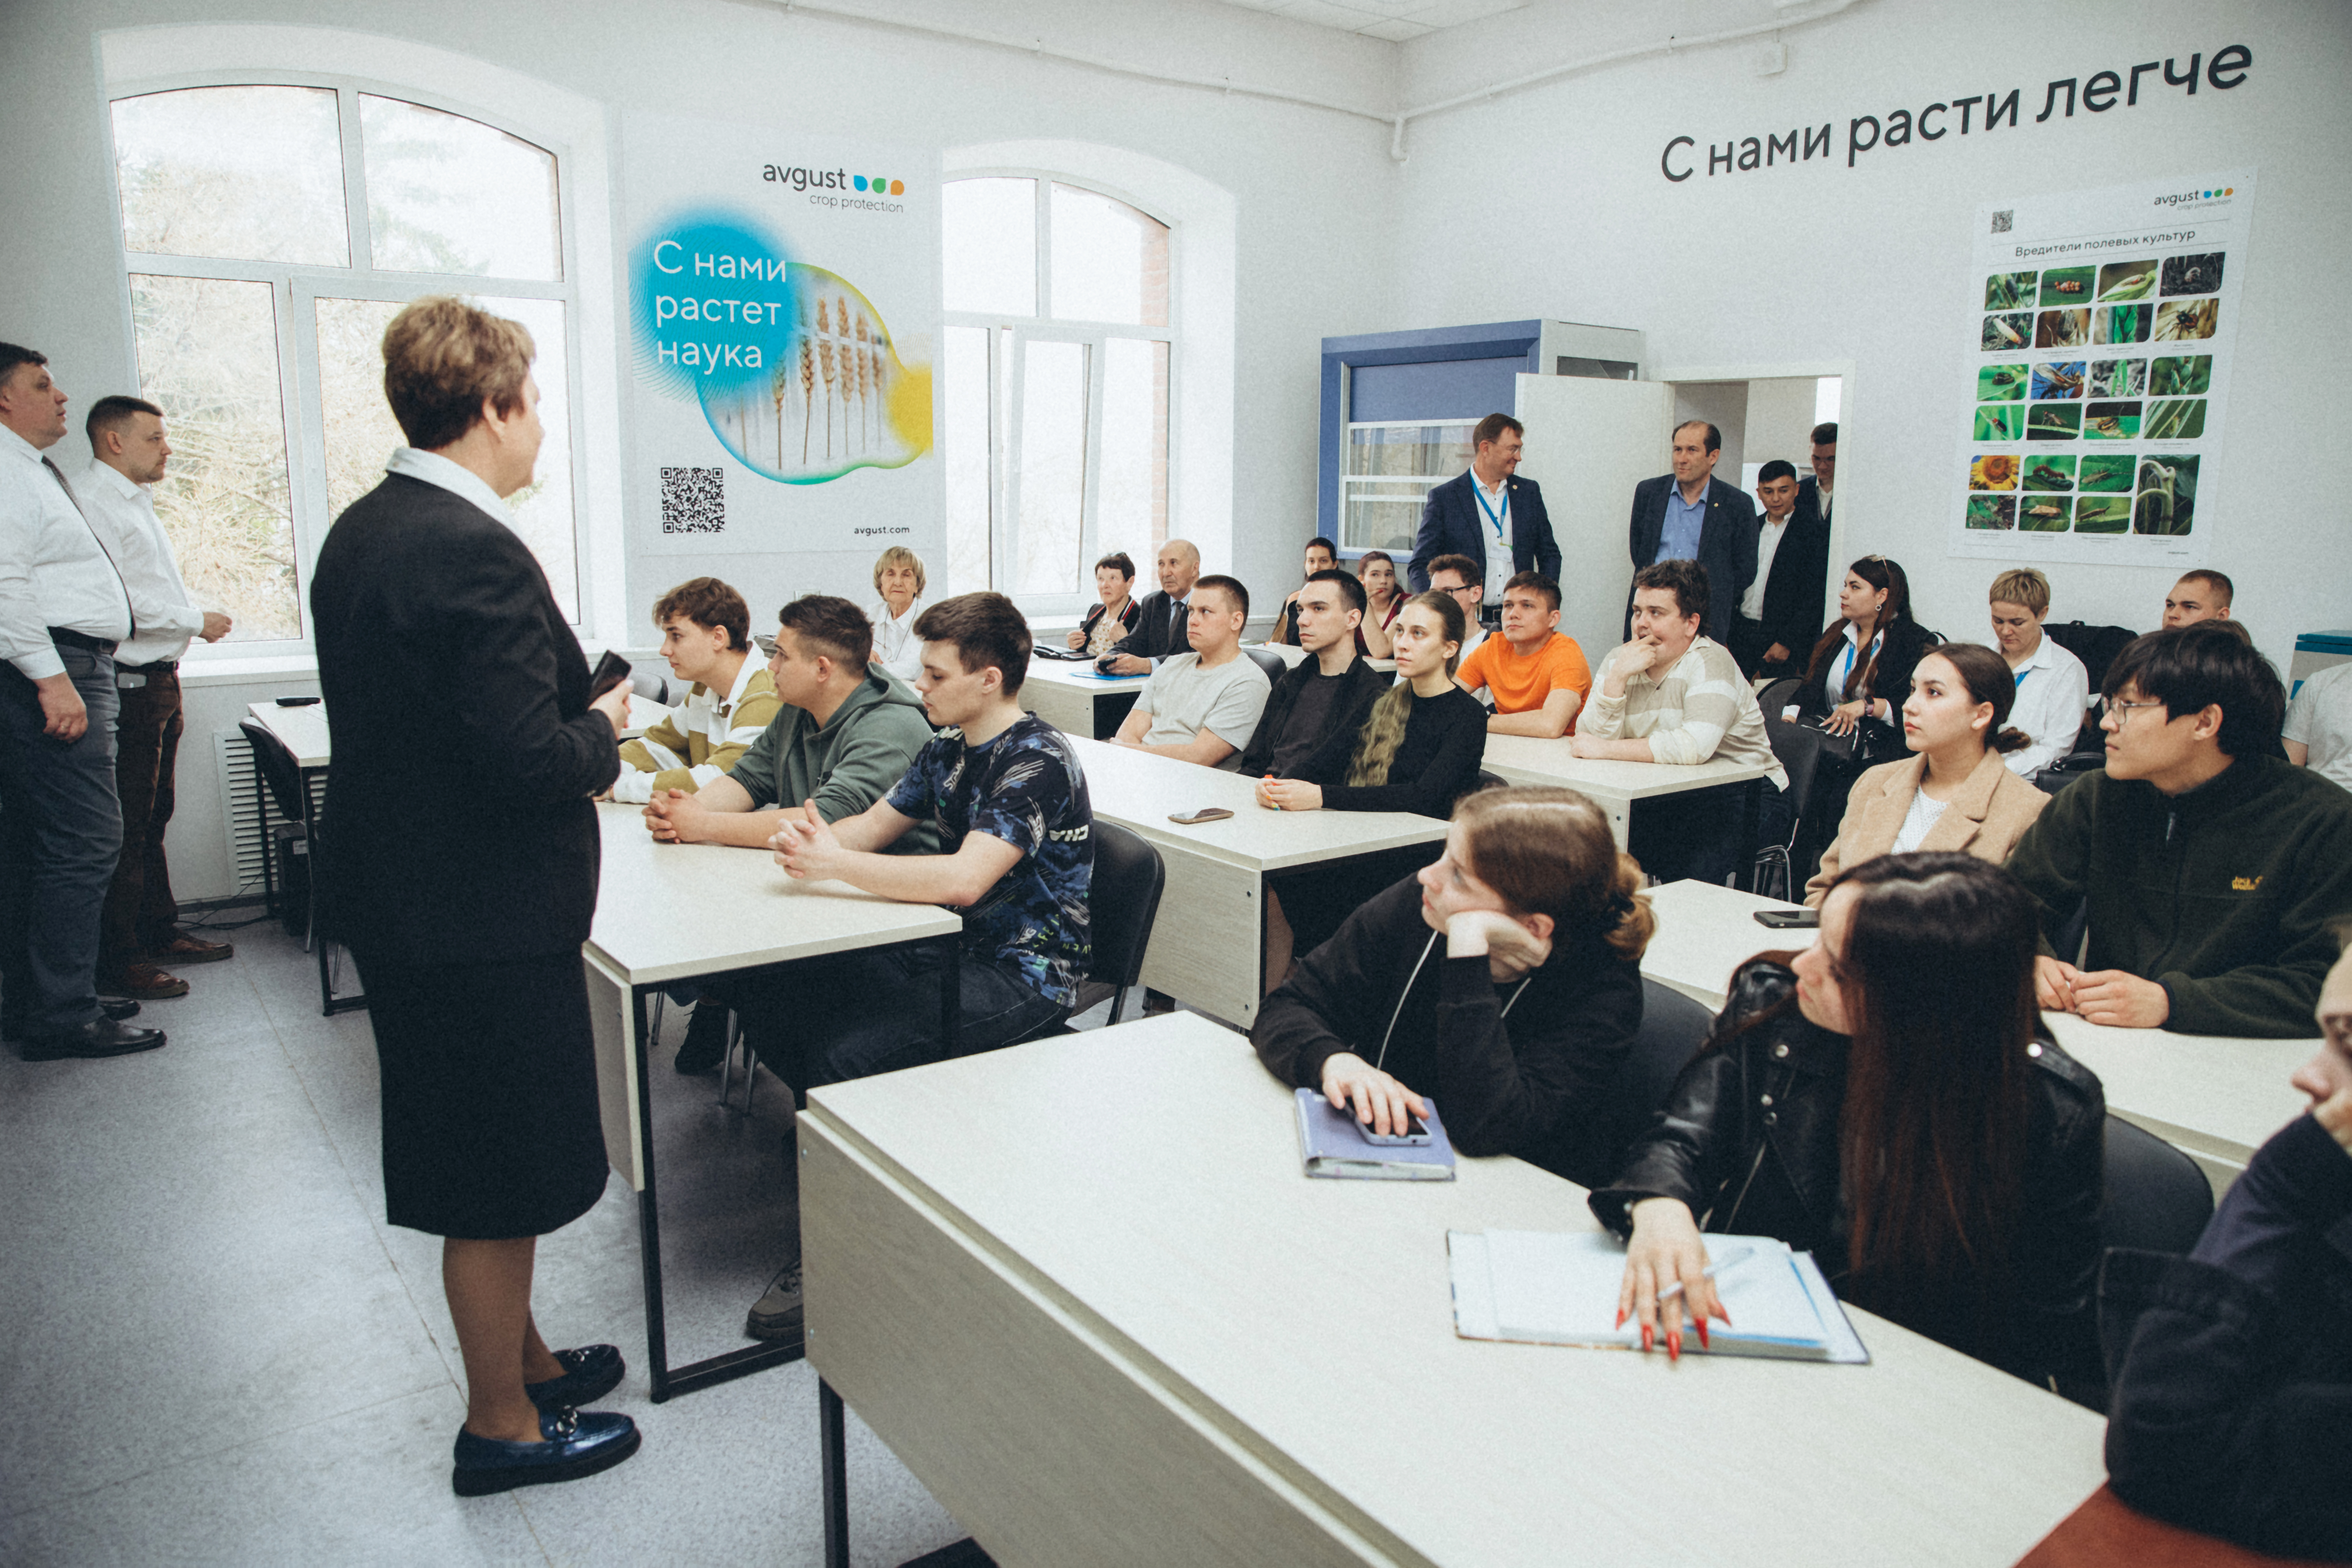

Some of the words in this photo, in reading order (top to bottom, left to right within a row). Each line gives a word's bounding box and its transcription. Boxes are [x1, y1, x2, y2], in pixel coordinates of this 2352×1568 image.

[1661, 135, 1695, 182] С
[1708, 123, 1832, 176] нами
[1848, 88, 2021, 168] расти
[2035, 44, 2252, 123] легче
[763, 164, 847, 192] avgust
[809, 194, 838, 209] crop
[841, 198, 904, 213] protection
[2154, 189, 2199, 207] avgust
[2194, 198, 2232, 210] protection
[2015, 243, 2081, 257] Вредители
[2084, 237, 2139, 250] полевых
[2142, 229, 2196, 246] культур
[654, 240, 683, 274] С
[694, 252, 786, 283] нами
[656, 295, 782, 328] растет
[658, 340, 762, 375] наука
[853, 526, 910, 537] avgust.com
